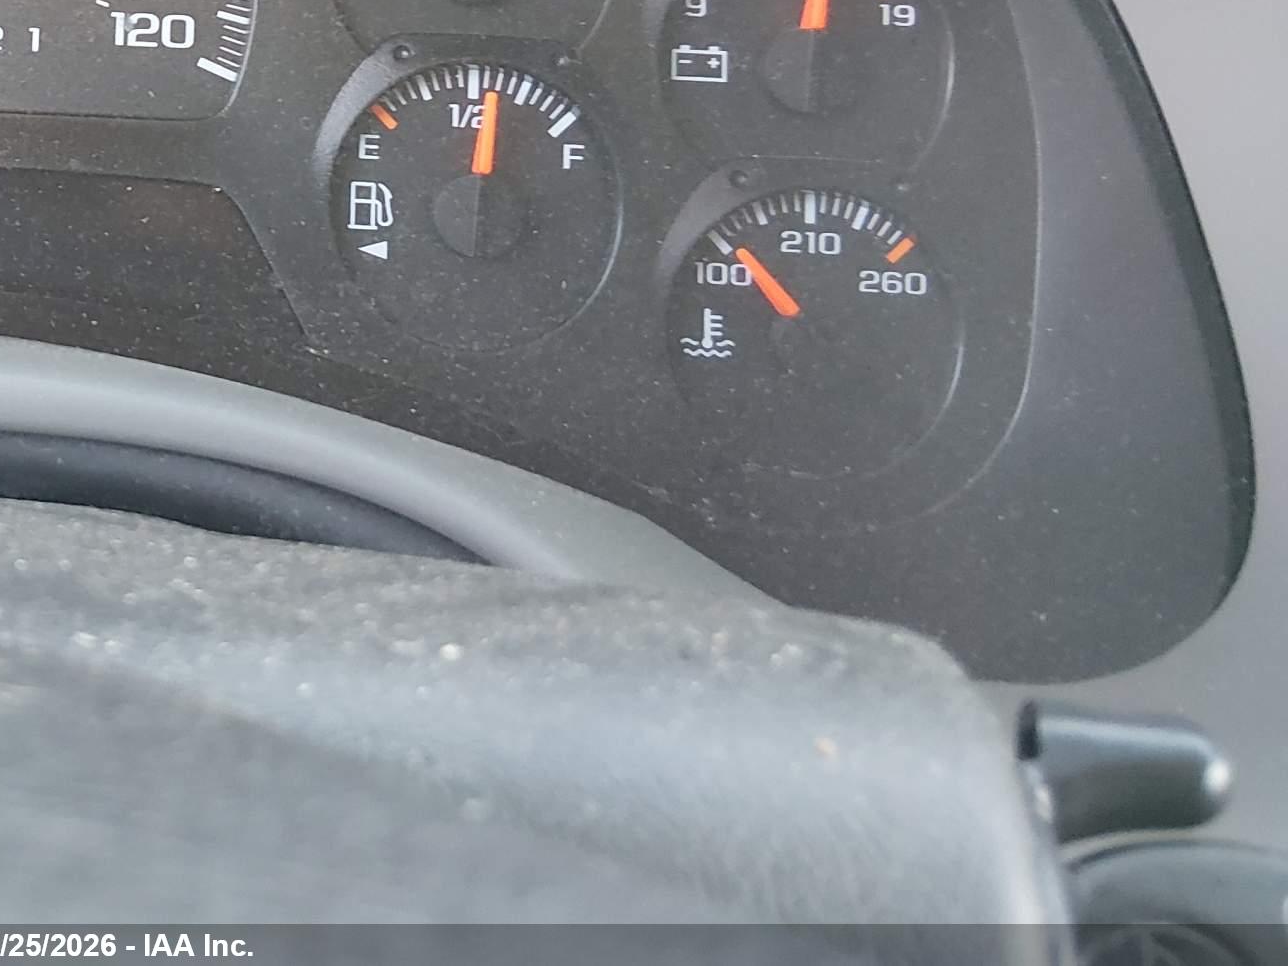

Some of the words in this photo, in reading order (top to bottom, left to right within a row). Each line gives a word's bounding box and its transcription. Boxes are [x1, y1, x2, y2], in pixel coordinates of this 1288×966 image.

[880, 4, 915, 26] 19
[29, 28, 39, 51] 1
[111, 12, 194, 48] 120
[359, 135, 380, 159] E
[563, 144, 584, 169] F
[781, 231, 840, 254] 210
[696, 262, 752, 286] 100
[859, 271, 926, 294] 260
